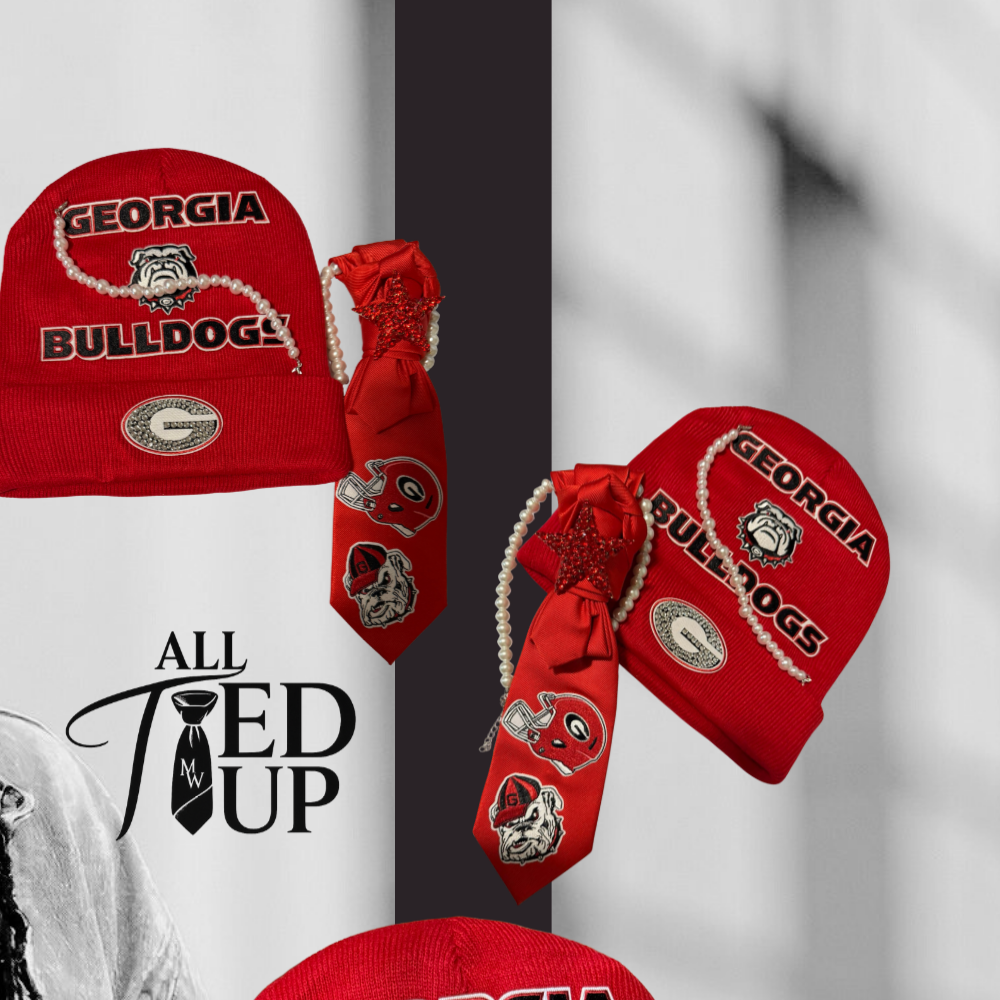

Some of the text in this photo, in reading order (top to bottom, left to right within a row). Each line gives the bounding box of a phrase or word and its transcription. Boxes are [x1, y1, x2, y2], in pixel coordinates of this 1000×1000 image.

[63, 191, 270, 238] GEORGIA
[41, 314, 290, 361] BULLDOGS
[730, 430, 877, 568] GEORGIA
